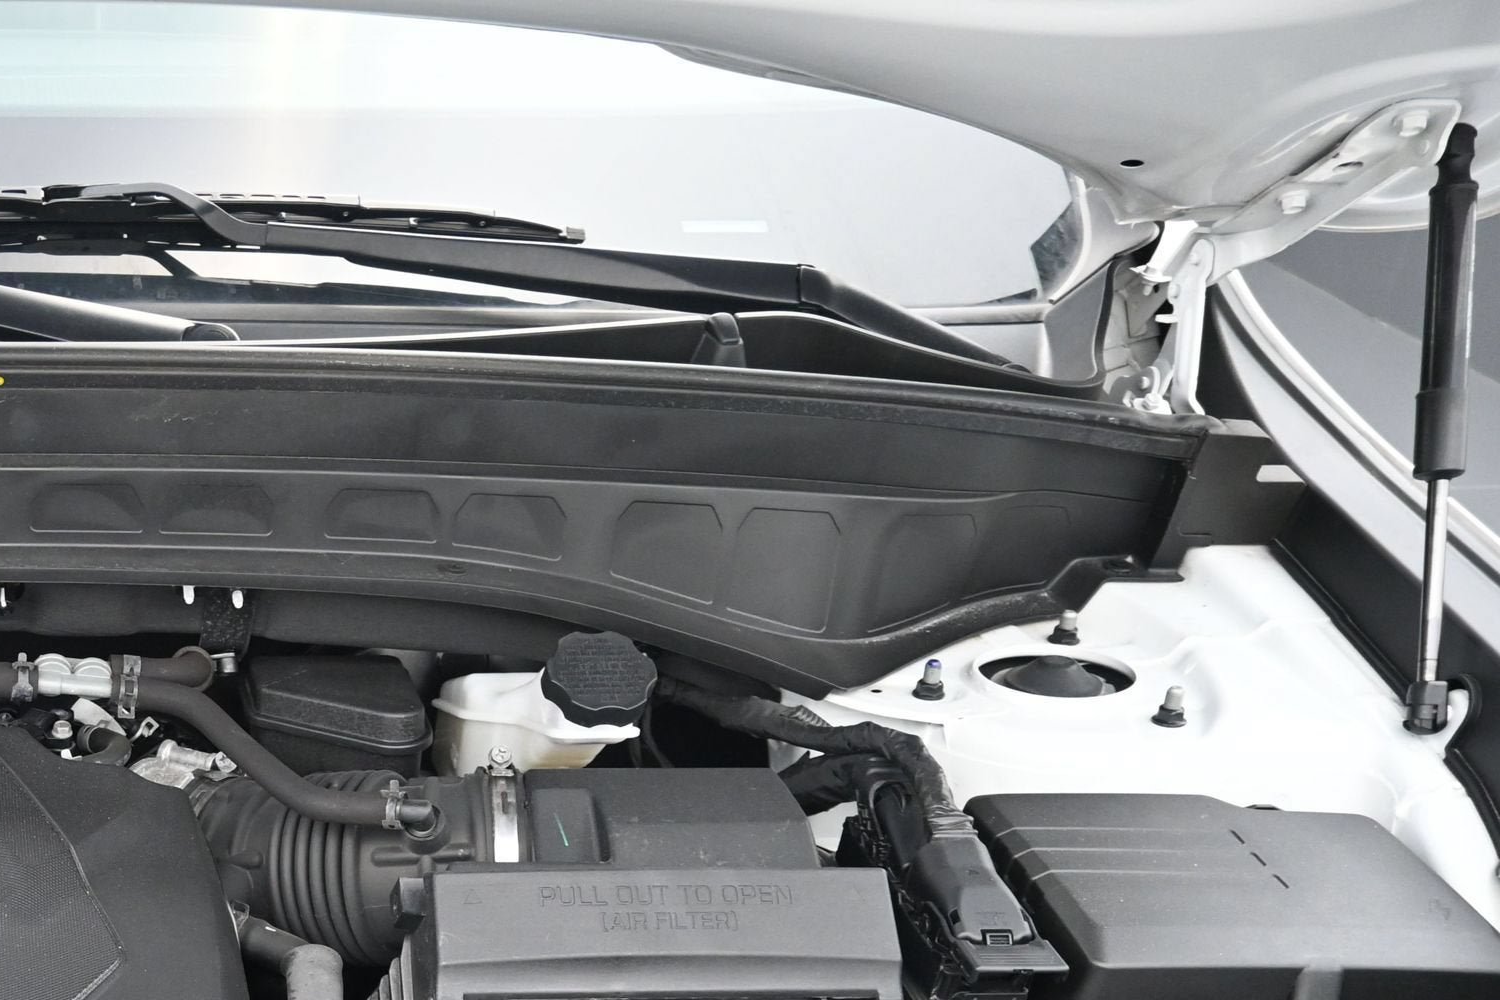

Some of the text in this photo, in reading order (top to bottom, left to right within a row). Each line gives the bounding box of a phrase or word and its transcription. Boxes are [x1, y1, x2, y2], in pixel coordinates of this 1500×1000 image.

[539, 884, 793, 907] PULL OUT TO OPEN
